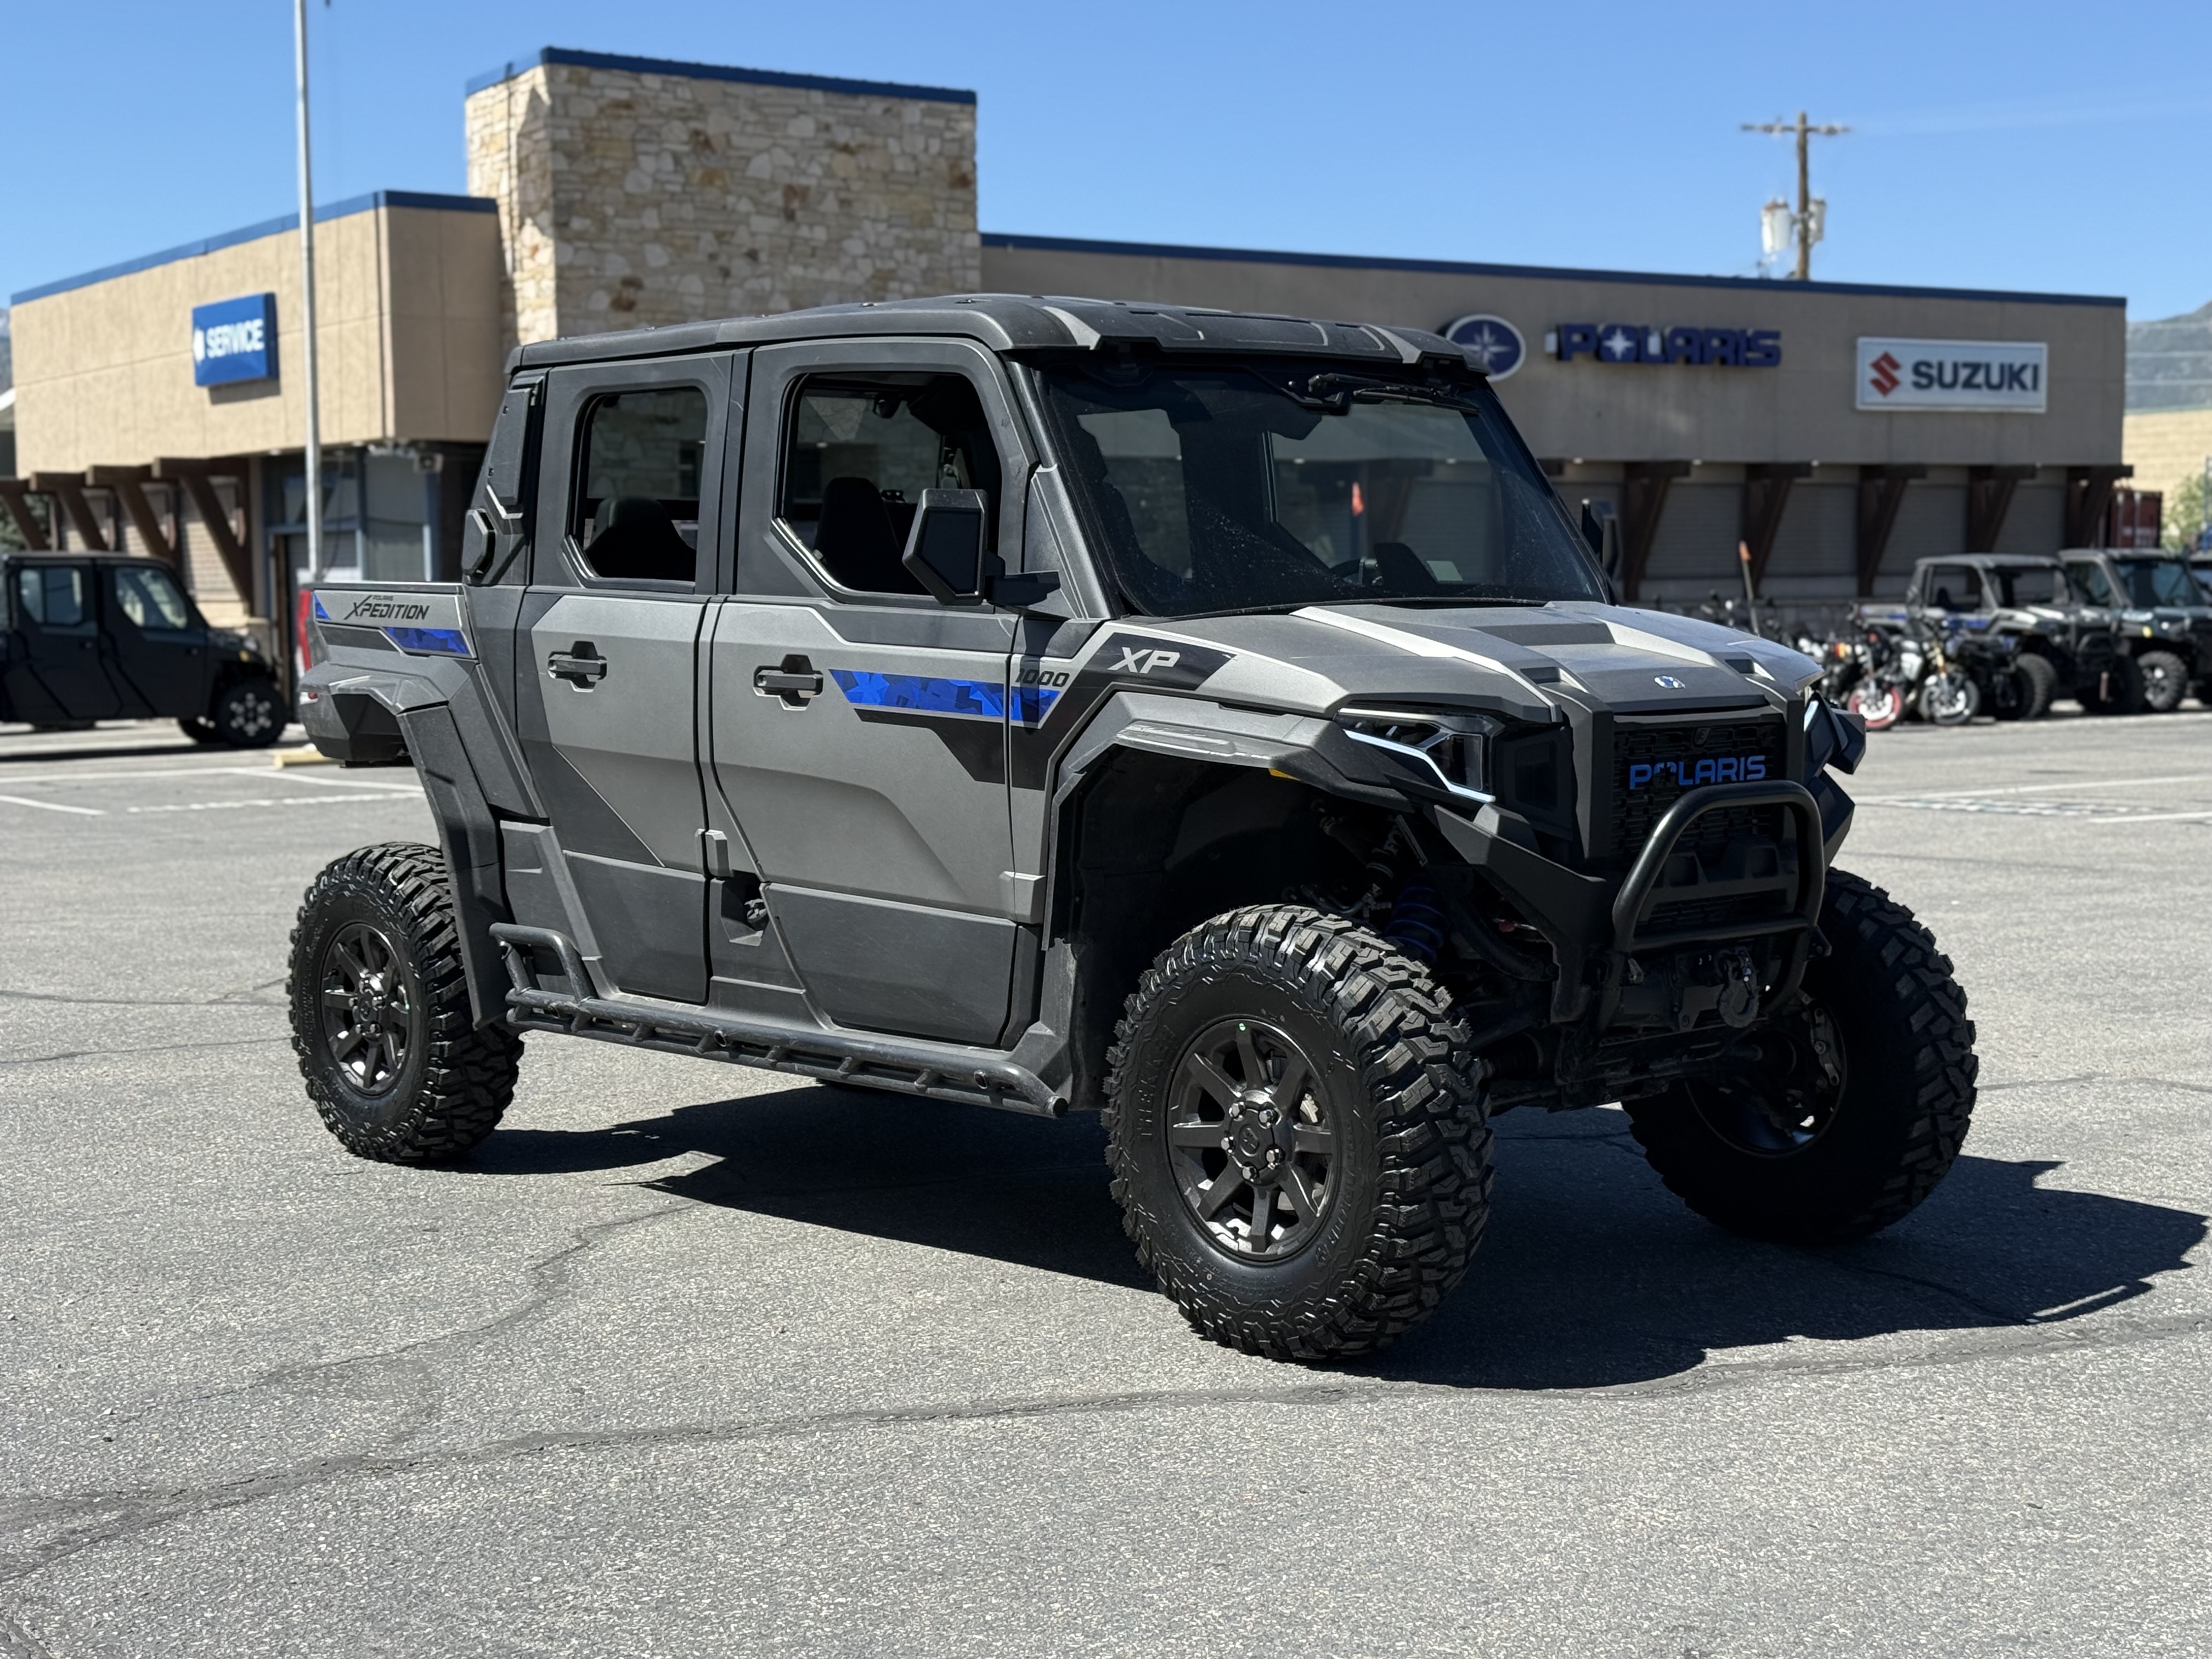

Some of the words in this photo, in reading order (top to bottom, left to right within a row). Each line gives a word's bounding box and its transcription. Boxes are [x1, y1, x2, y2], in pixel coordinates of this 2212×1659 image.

[1559, 323, 1781, 367] POLARIS
[1911, 360, 2040, 391] SUZUKI
[343, 595, 431, 620] XPEDITION
[1107, 647, 1180, 674] XP
[1015, 669, 1070, 687] 1000
[1629, 755, 1766, 789] POLARIS
